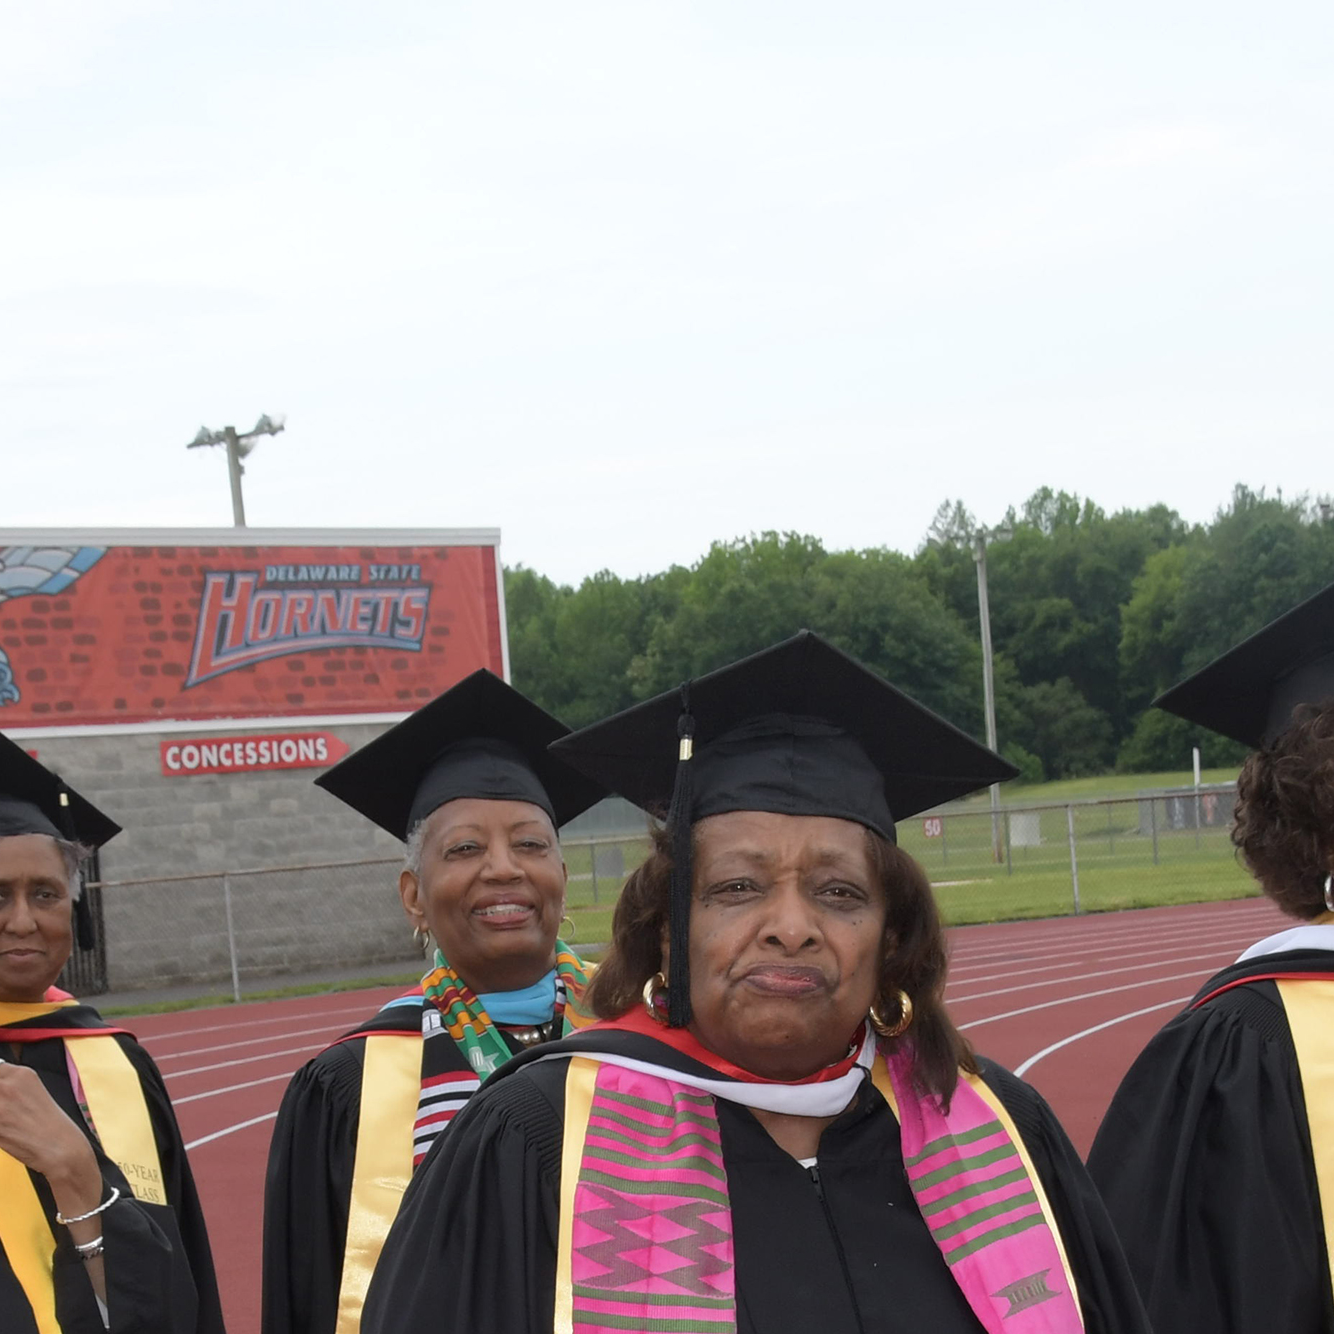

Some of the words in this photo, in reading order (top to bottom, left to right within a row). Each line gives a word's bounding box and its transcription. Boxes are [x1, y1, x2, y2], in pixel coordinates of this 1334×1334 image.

[265, 564, 362, 582] DELAWARE
[369, 563, 421, 581] STATE
[183, 570, 432, 691] HORNETS
[166, 737, 328, 770] CONCESSIONS
